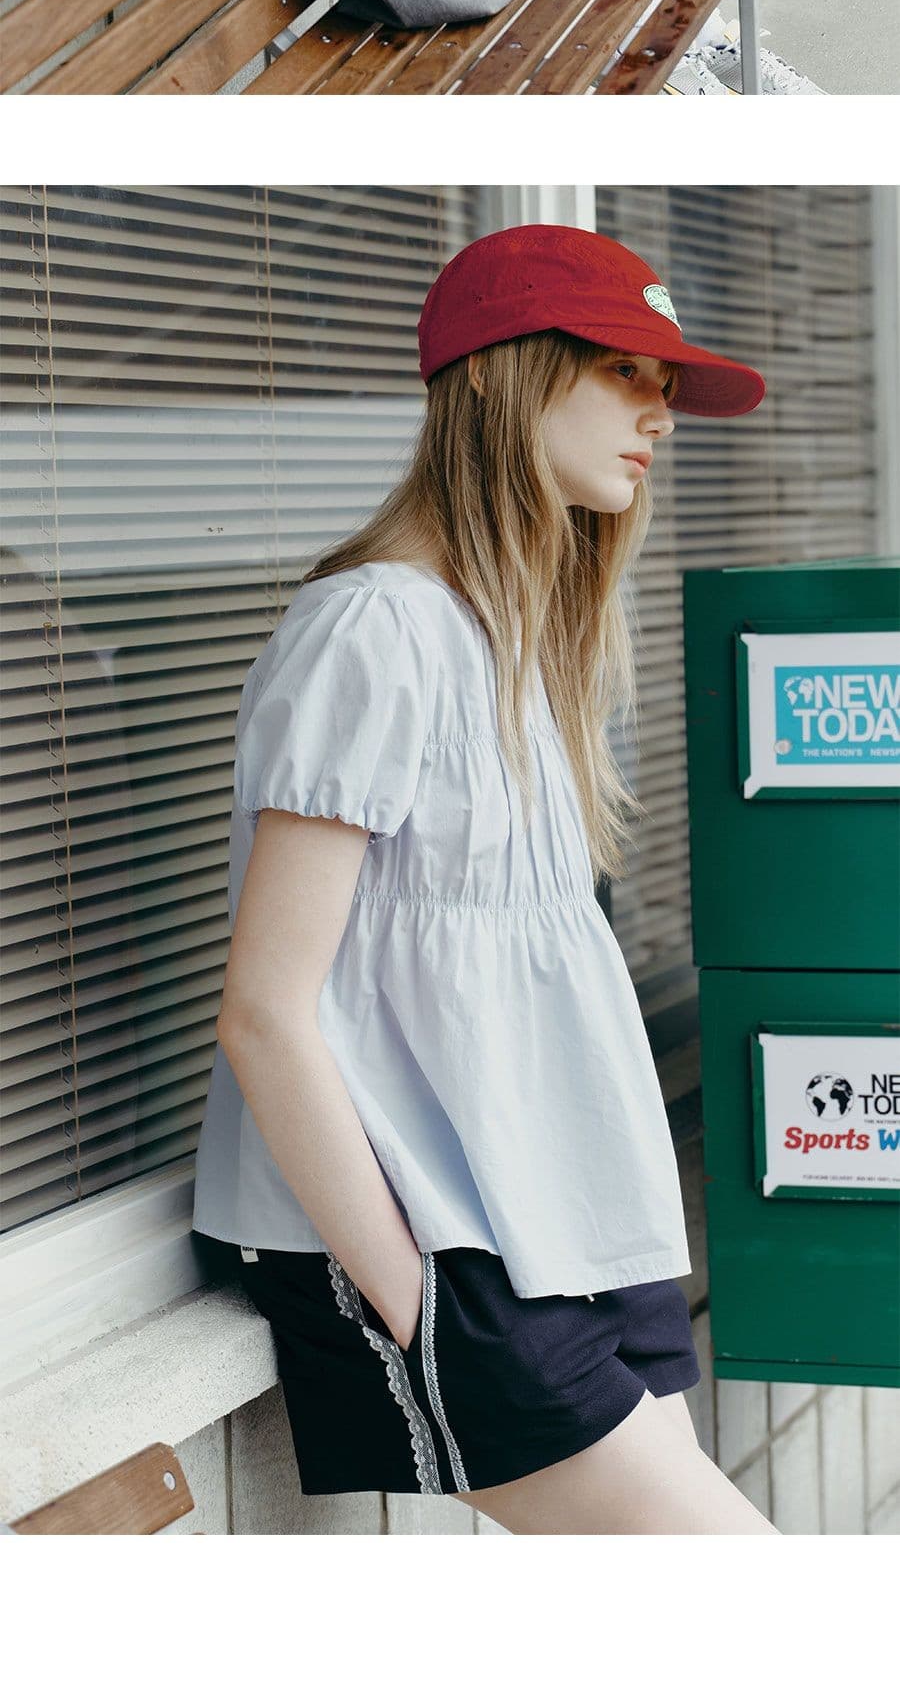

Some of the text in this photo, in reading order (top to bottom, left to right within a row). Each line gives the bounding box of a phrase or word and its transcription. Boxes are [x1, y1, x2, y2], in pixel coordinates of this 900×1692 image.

[803, 748, 820, 757] THE
[821, 748, 863, 757] NATION'S
[784, 1126, 870, 1154] Sports
